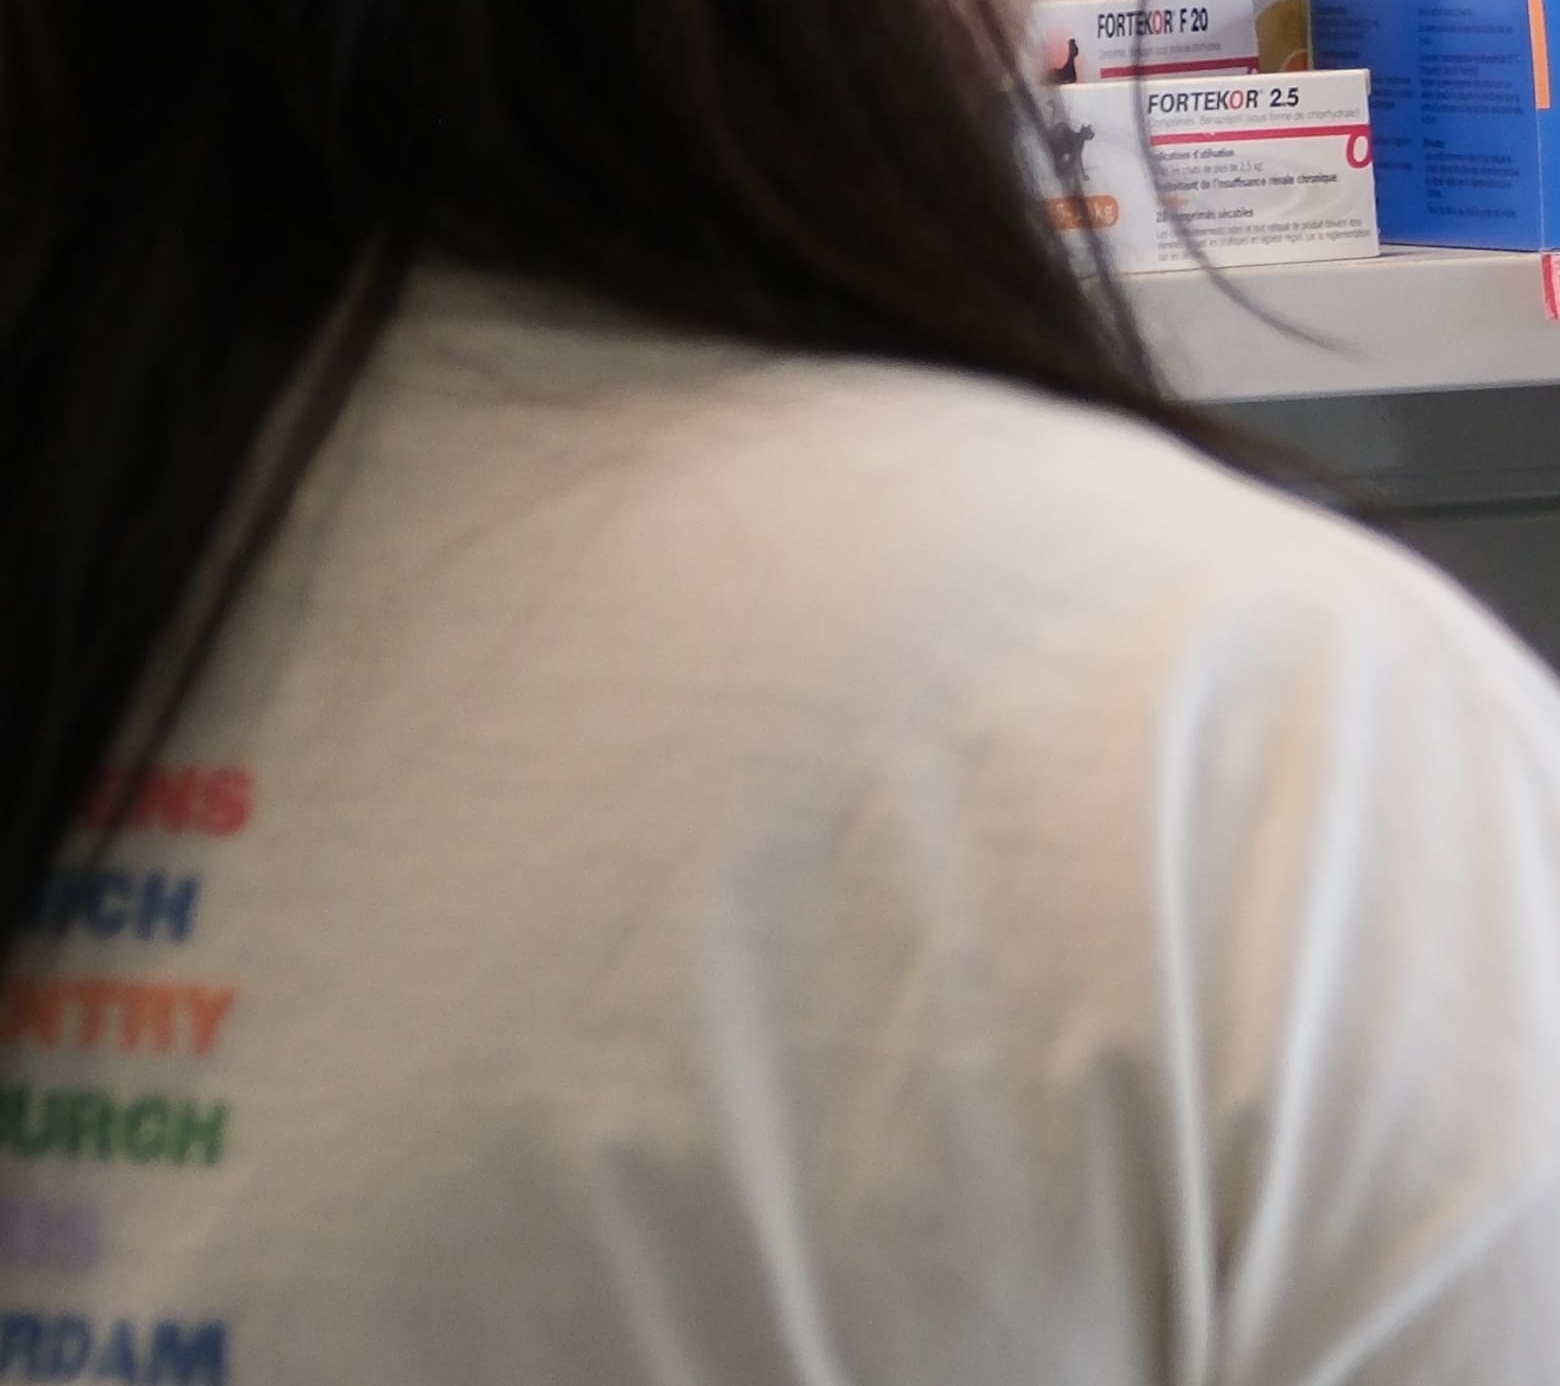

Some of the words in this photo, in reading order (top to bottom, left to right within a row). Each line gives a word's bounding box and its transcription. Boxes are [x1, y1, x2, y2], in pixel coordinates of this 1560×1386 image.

[1096, 9, 1174, 39] FORTEKOR
[1178, 8, 1190, 33] F
[1190, 6, 1209, 33] 20
[1148, 88, 1261, 115] FORTEKOR
[1269, 86, 1300, 109] 2.5
